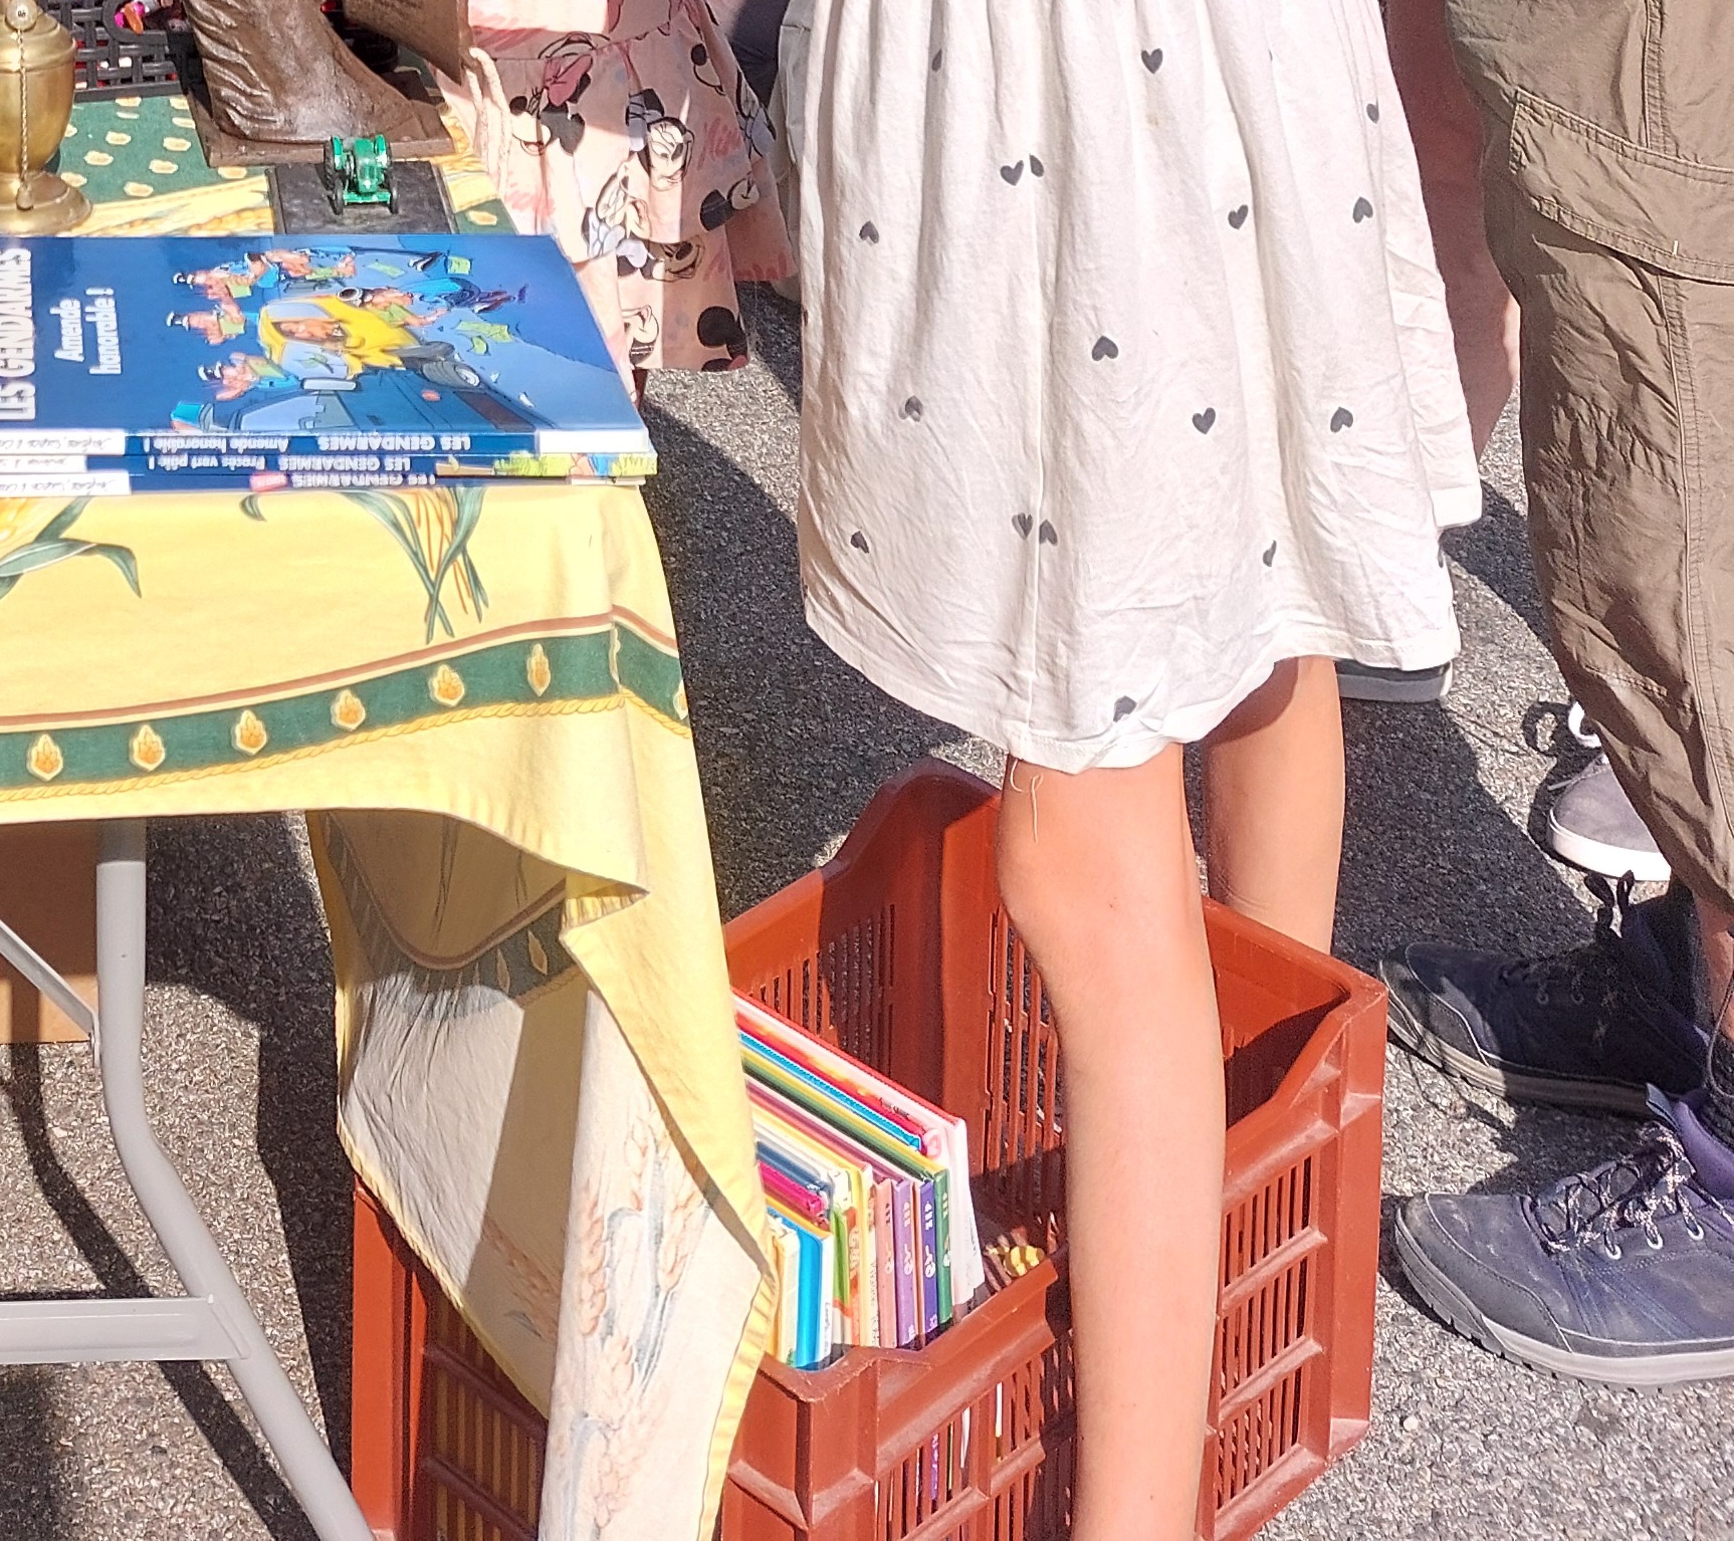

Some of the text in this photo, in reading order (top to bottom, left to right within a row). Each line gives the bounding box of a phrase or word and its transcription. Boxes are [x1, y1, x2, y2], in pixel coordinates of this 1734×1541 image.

[50, 298, 84, 362] Amende
[85, 298, 122, 375] honorable
[154, 436, 227, 454] honorable
[231, 436, 289, 453] Amende
[317, 436, 435, 451] GENDARMES
[440, 436, 471, 451] LES
[277, 455, 380, 470] GENDARMES
[385, 455, 411, 470] LES
[291, 473, 403, 487] GENDARMES
